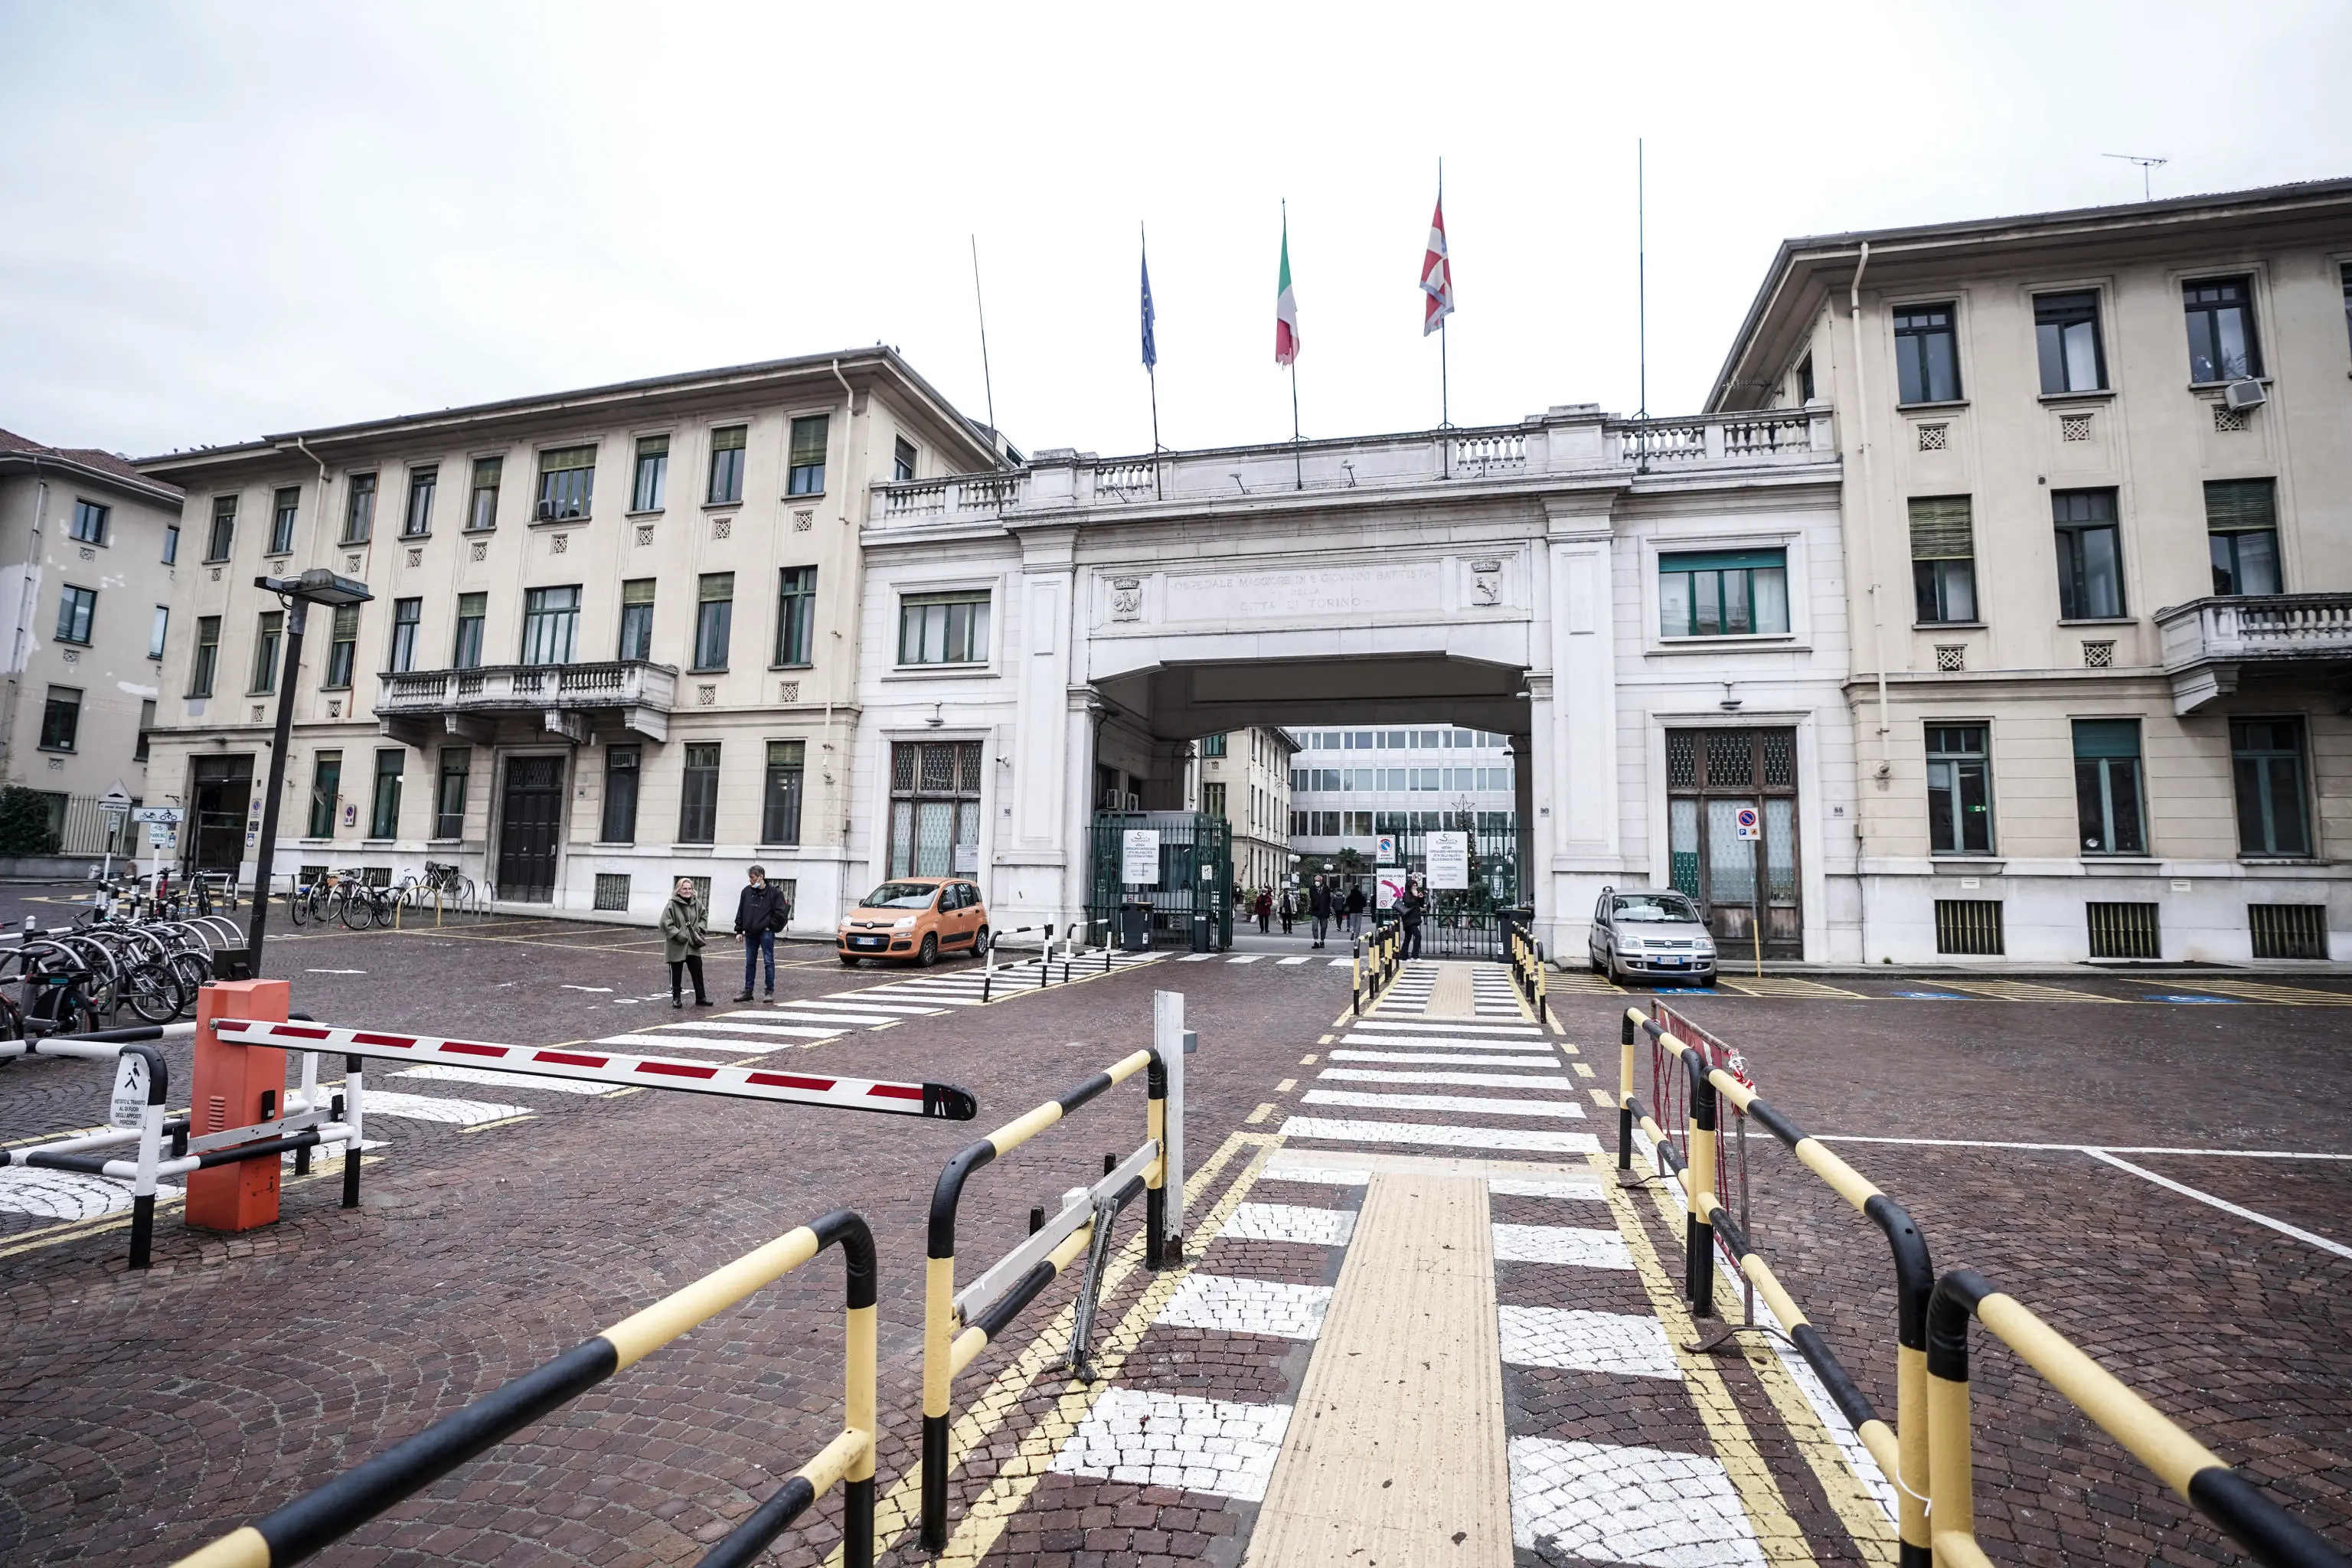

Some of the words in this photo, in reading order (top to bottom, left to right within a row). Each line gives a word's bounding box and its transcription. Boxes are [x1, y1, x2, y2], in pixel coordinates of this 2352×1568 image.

[1174, 580, 1233, 590] OSPEDALE
[1240, 576, 1291, 588] MAGGIORE
[1295, 574, 1305, 585] DI
[1321, 571, 1370, 583] GIOVANNI
[1376, 569, 1432, 580] BATTISTA
[1308, 597, 1361, 609] TORINO
